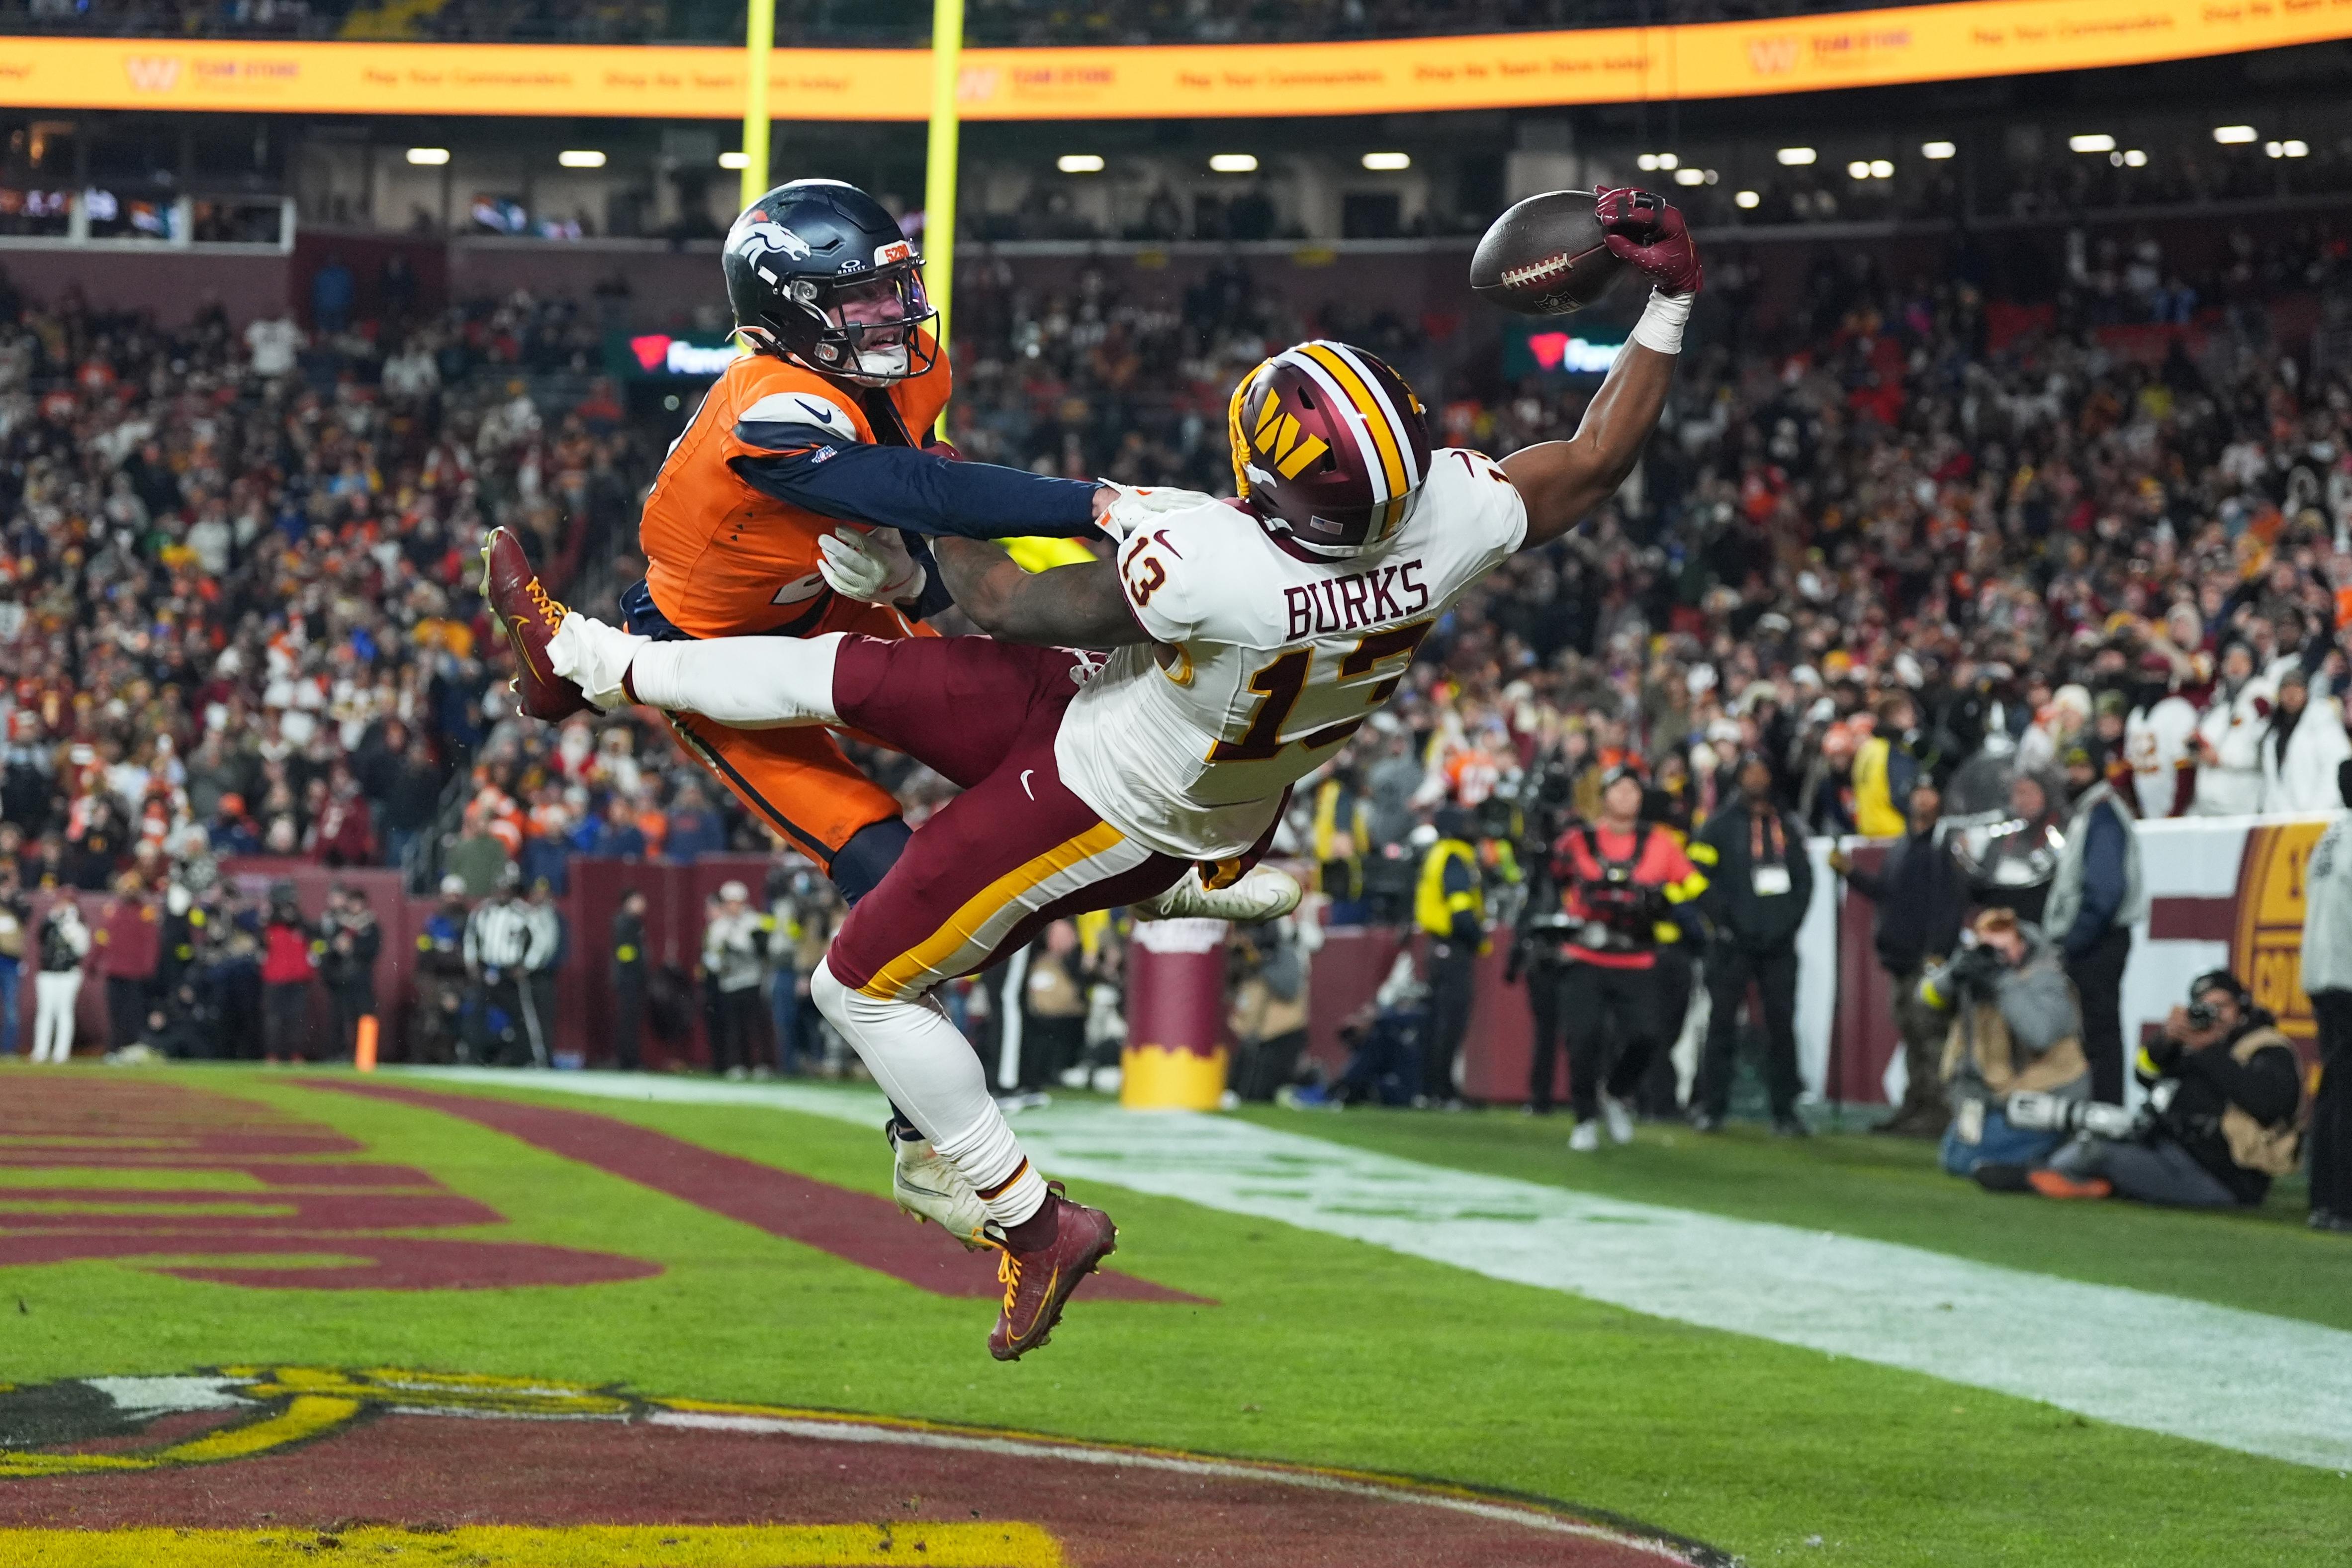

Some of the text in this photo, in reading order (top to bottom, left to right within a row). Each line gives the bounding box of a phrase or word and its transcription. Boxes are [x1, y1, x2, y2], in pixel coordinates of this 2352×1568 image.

[837, 265, 866, 275] OAKLEY
[1122, 536, 1166, 608] 13
[1284, 560, 1428, 641] BURKS
[1204, 618, 1436, 763] 13
